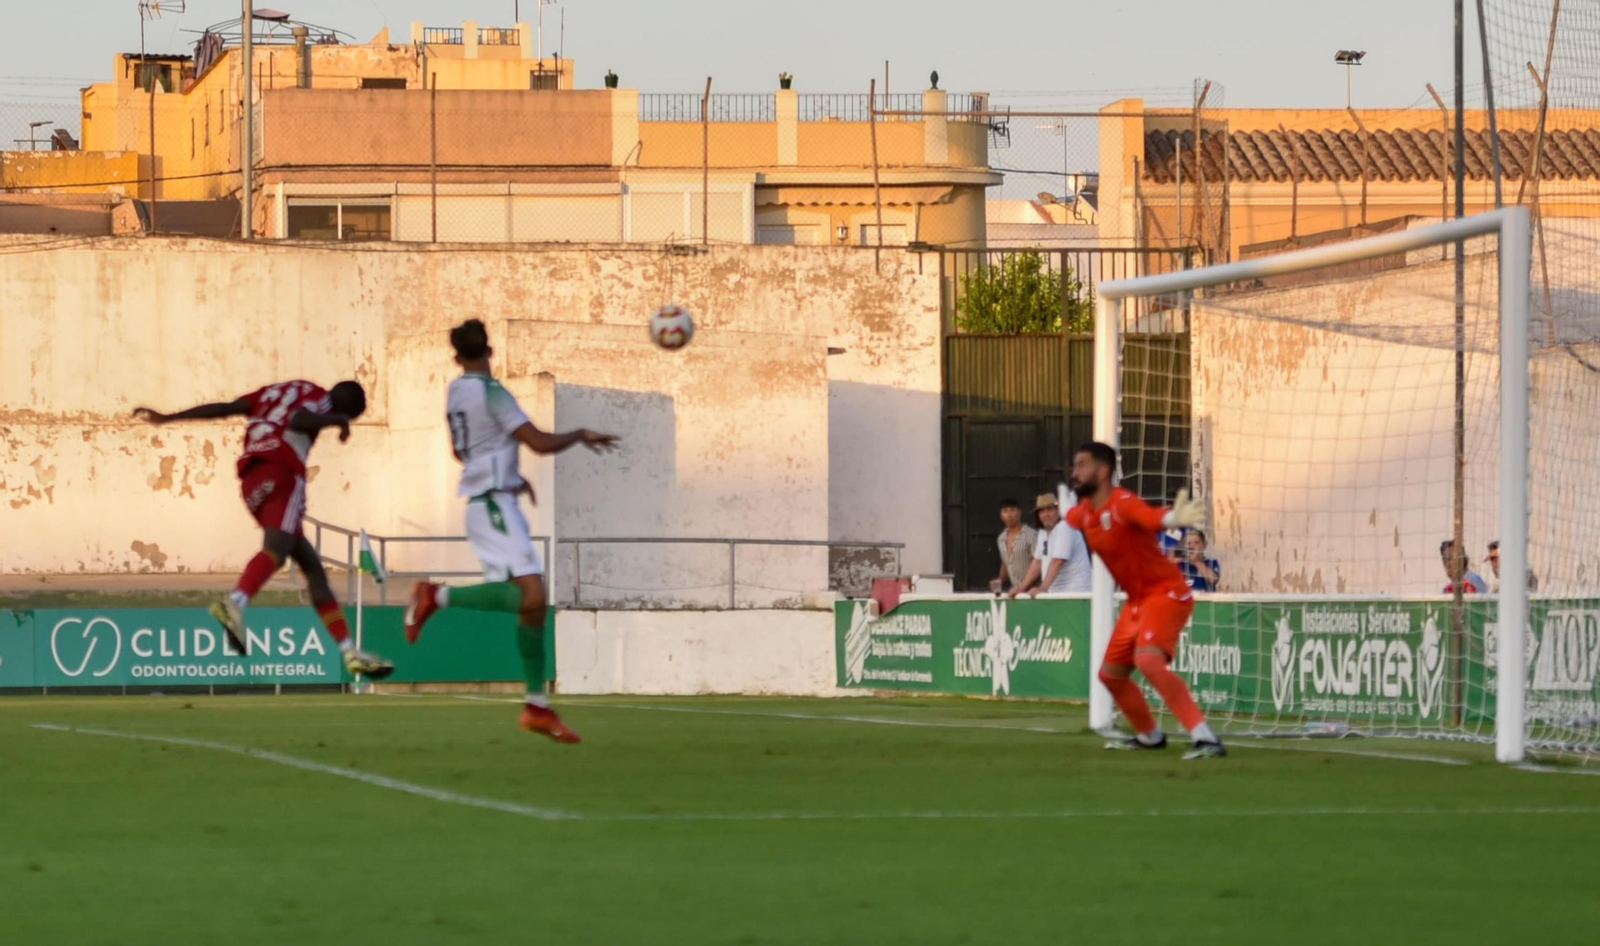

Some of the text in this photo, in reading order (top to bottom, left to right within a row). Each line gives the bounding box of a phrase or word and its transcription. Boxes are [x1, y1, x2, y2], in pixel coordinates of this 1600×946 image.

[965, 610, 993, 641] AGRO
[1302, 605, 1411, 640] Instalaciones y Servicios
[953, 640, 993, 678] TÉCNICA
[1008, 624, 1073, 671] Sanlúcar
[1179, 632, 1242, 686] Espartero
[131, 662, 326, 677] ODONTOLOGÍA INTEGRAL
[1300, 638, 1414, 699] FONGATER
